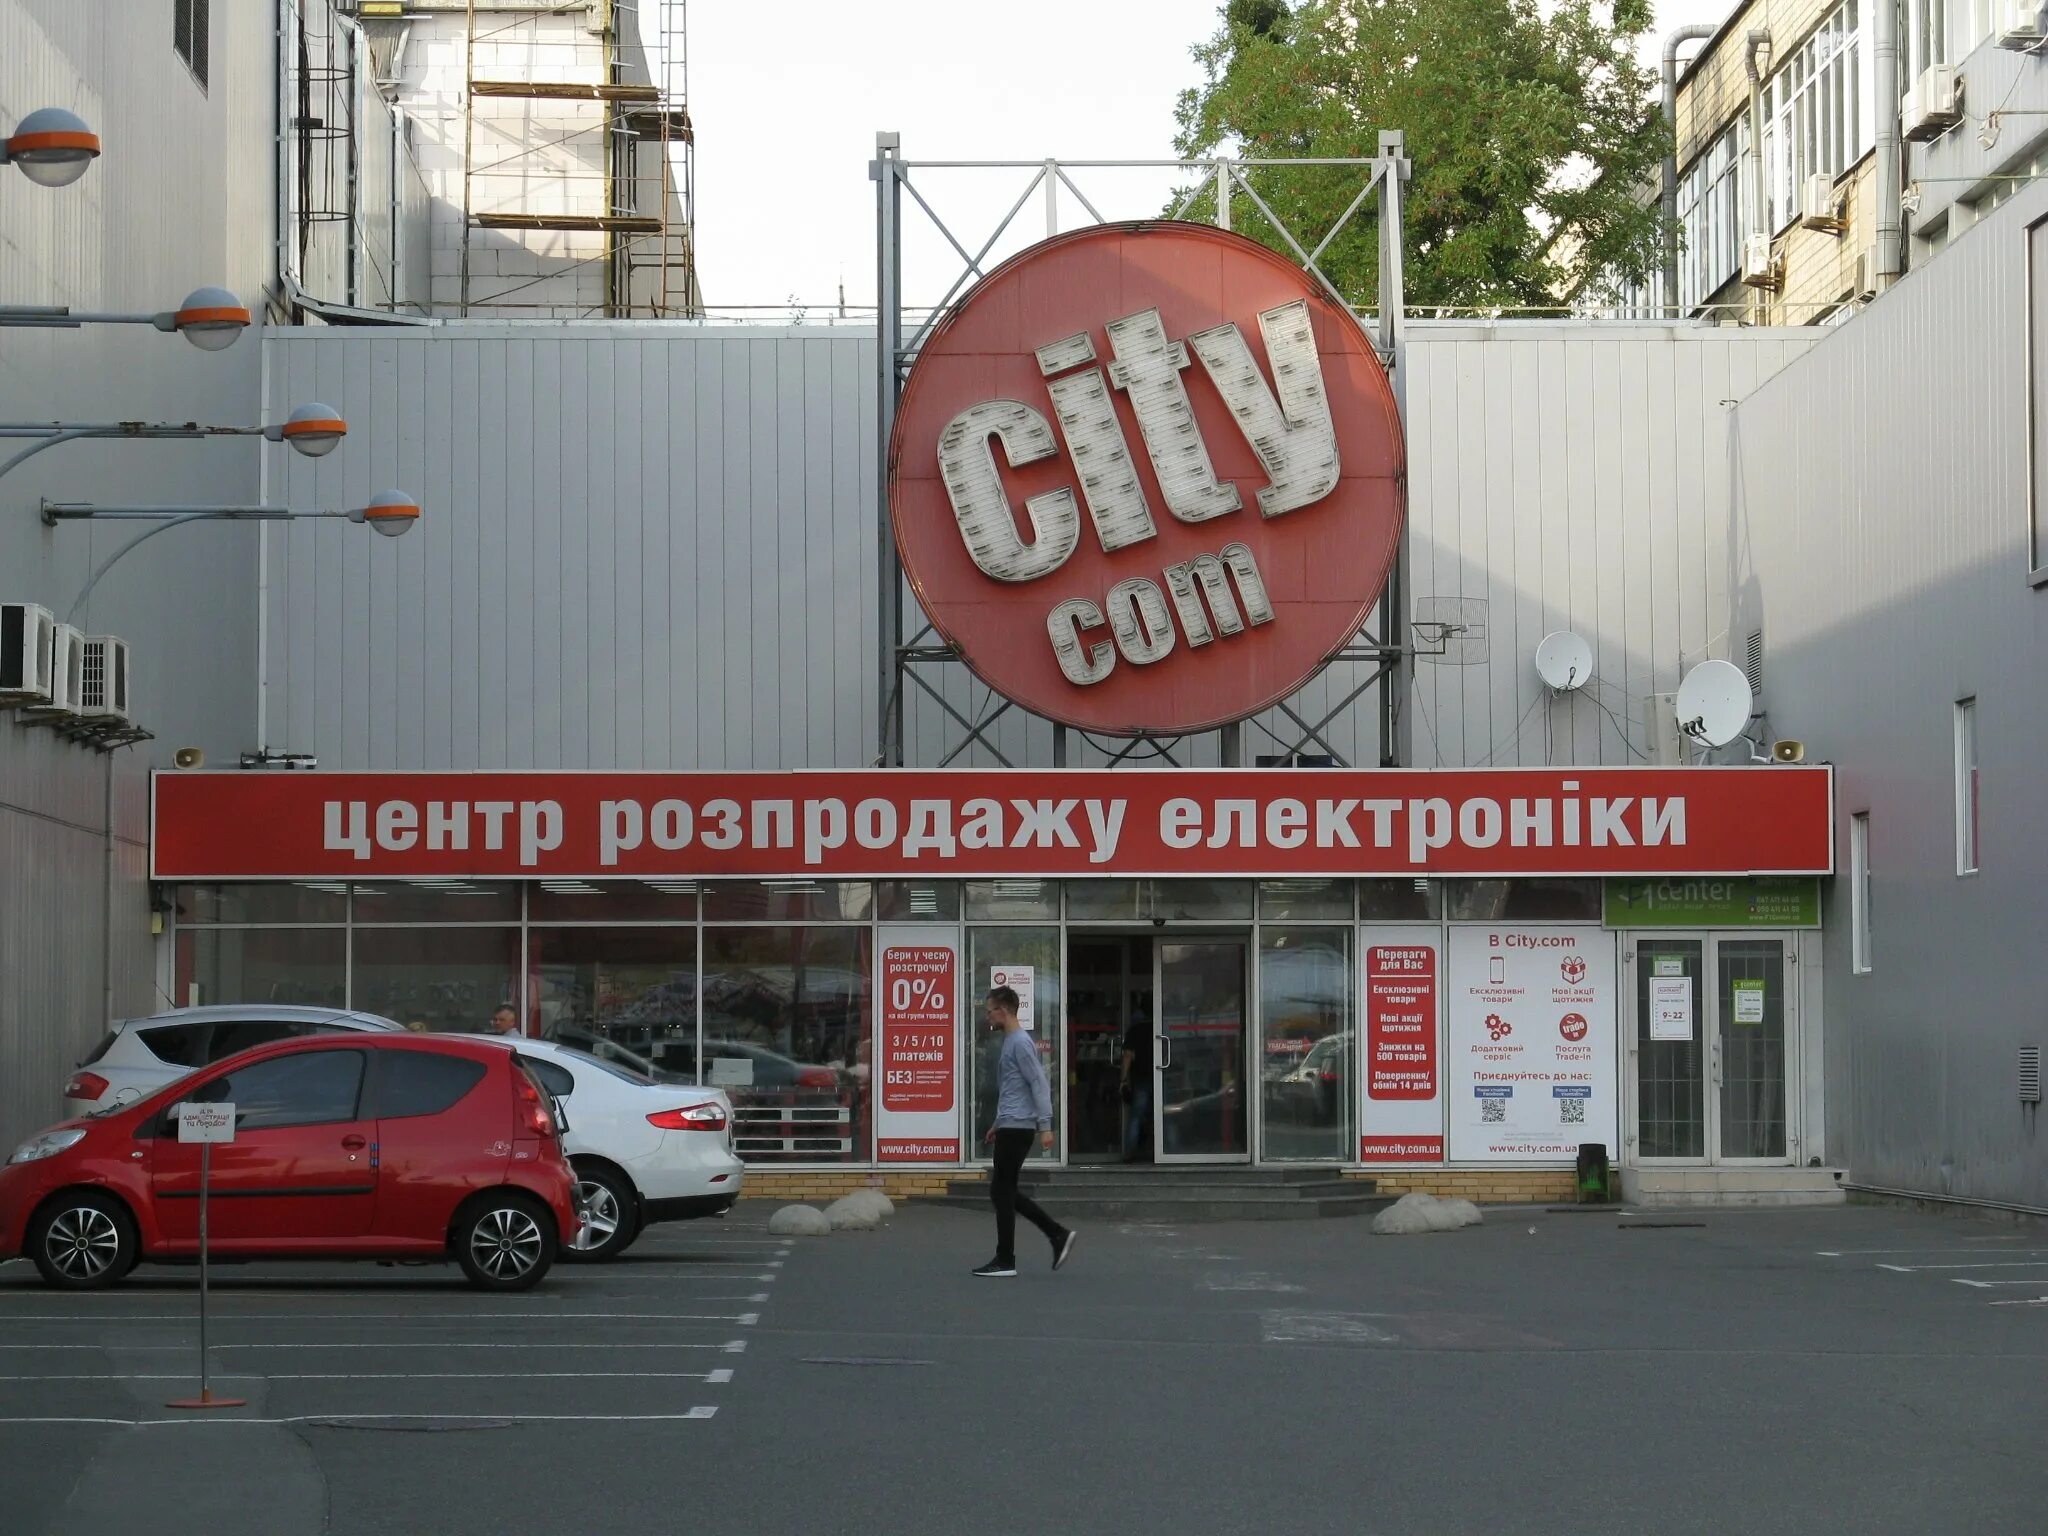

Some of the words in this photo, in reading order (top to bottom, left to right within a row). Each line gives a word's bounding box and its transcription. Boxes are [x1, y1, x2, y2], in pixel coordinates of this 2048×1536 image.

[937, 299, 1341, 581] city
[1046, 542, 1275, 686] com
[323, 799, 564, 866] центр
[601, 798, 1127, 863] розпродажу
[1159, 781, 1686, 863] електроніки
[1505, 934, 1576, 949] City.com
[887, 950, 911, 962] Бери
[914, 952, 920, 961] у
[922, 952, 950, 961] чесну
[1377, 949, 1427, 961] Переваги
[890, 962, 948, 974] розстрочку!
[1381, 961, 1400, 971] для
[1404, 960, 1423, 970] Вас
[893, 978, 945, 1010] 0%
[1374, 985, 1430, 994] Ексклюзивні
[1470, 987, 1525, 995] Ексклюзивні
[1552, 987, 1571, 995] Нові
[1574, 987, 1594, 996] акції
[1386, 996, 1416, 1005] товари
[1481, 996, 1513, 1004] товари
[1552, 996, 1594, 1004] щотижня
[1381, 1014, 1399, 1023] Нові
[1402, 1014, 1423, 1023] акції
[1382, 1025, 1421, 1033] щотижня
[893, 1036, 900, 1047] 3
[912, 1036, 918, 1047] 5
[930, 1036, 944, 1047] 10
[1378, 1043, 1412, 1051] Знижки
[1471, 1045, 1523, 1053] Додатковий
[1555, 1045, 1591, 1053] Послуга
[893, 1050, 943, 1062] платежів
[1377, 1052, 1393, 1061] 500
[1395, 1052, 1427, 1062] товарів
[1484, 1053, 1511, 1062] сервіс
[1556, 1053, 1591, 1061] Trade-In
[887, 1070, 912, 1084] БЕЗ
[1375, 1071, 1430, 1081] Повернення/
[1473, 1070, 1550, 1082] Приєднуйтесь
[1553, 1073, 1567, 1082] до
[1373, 1081, 1397, 1090] обмін
[1400, 1081, 1410, 1090] 14
[1413, 1081, 1431, 1091] днів
[881, 1144, 955, 1155] www.city.com.ua
[1365, 1144, 1441, 1155] www.city.com.ua
[1489, 1144, 1577, 1154] www.city.com.ua
